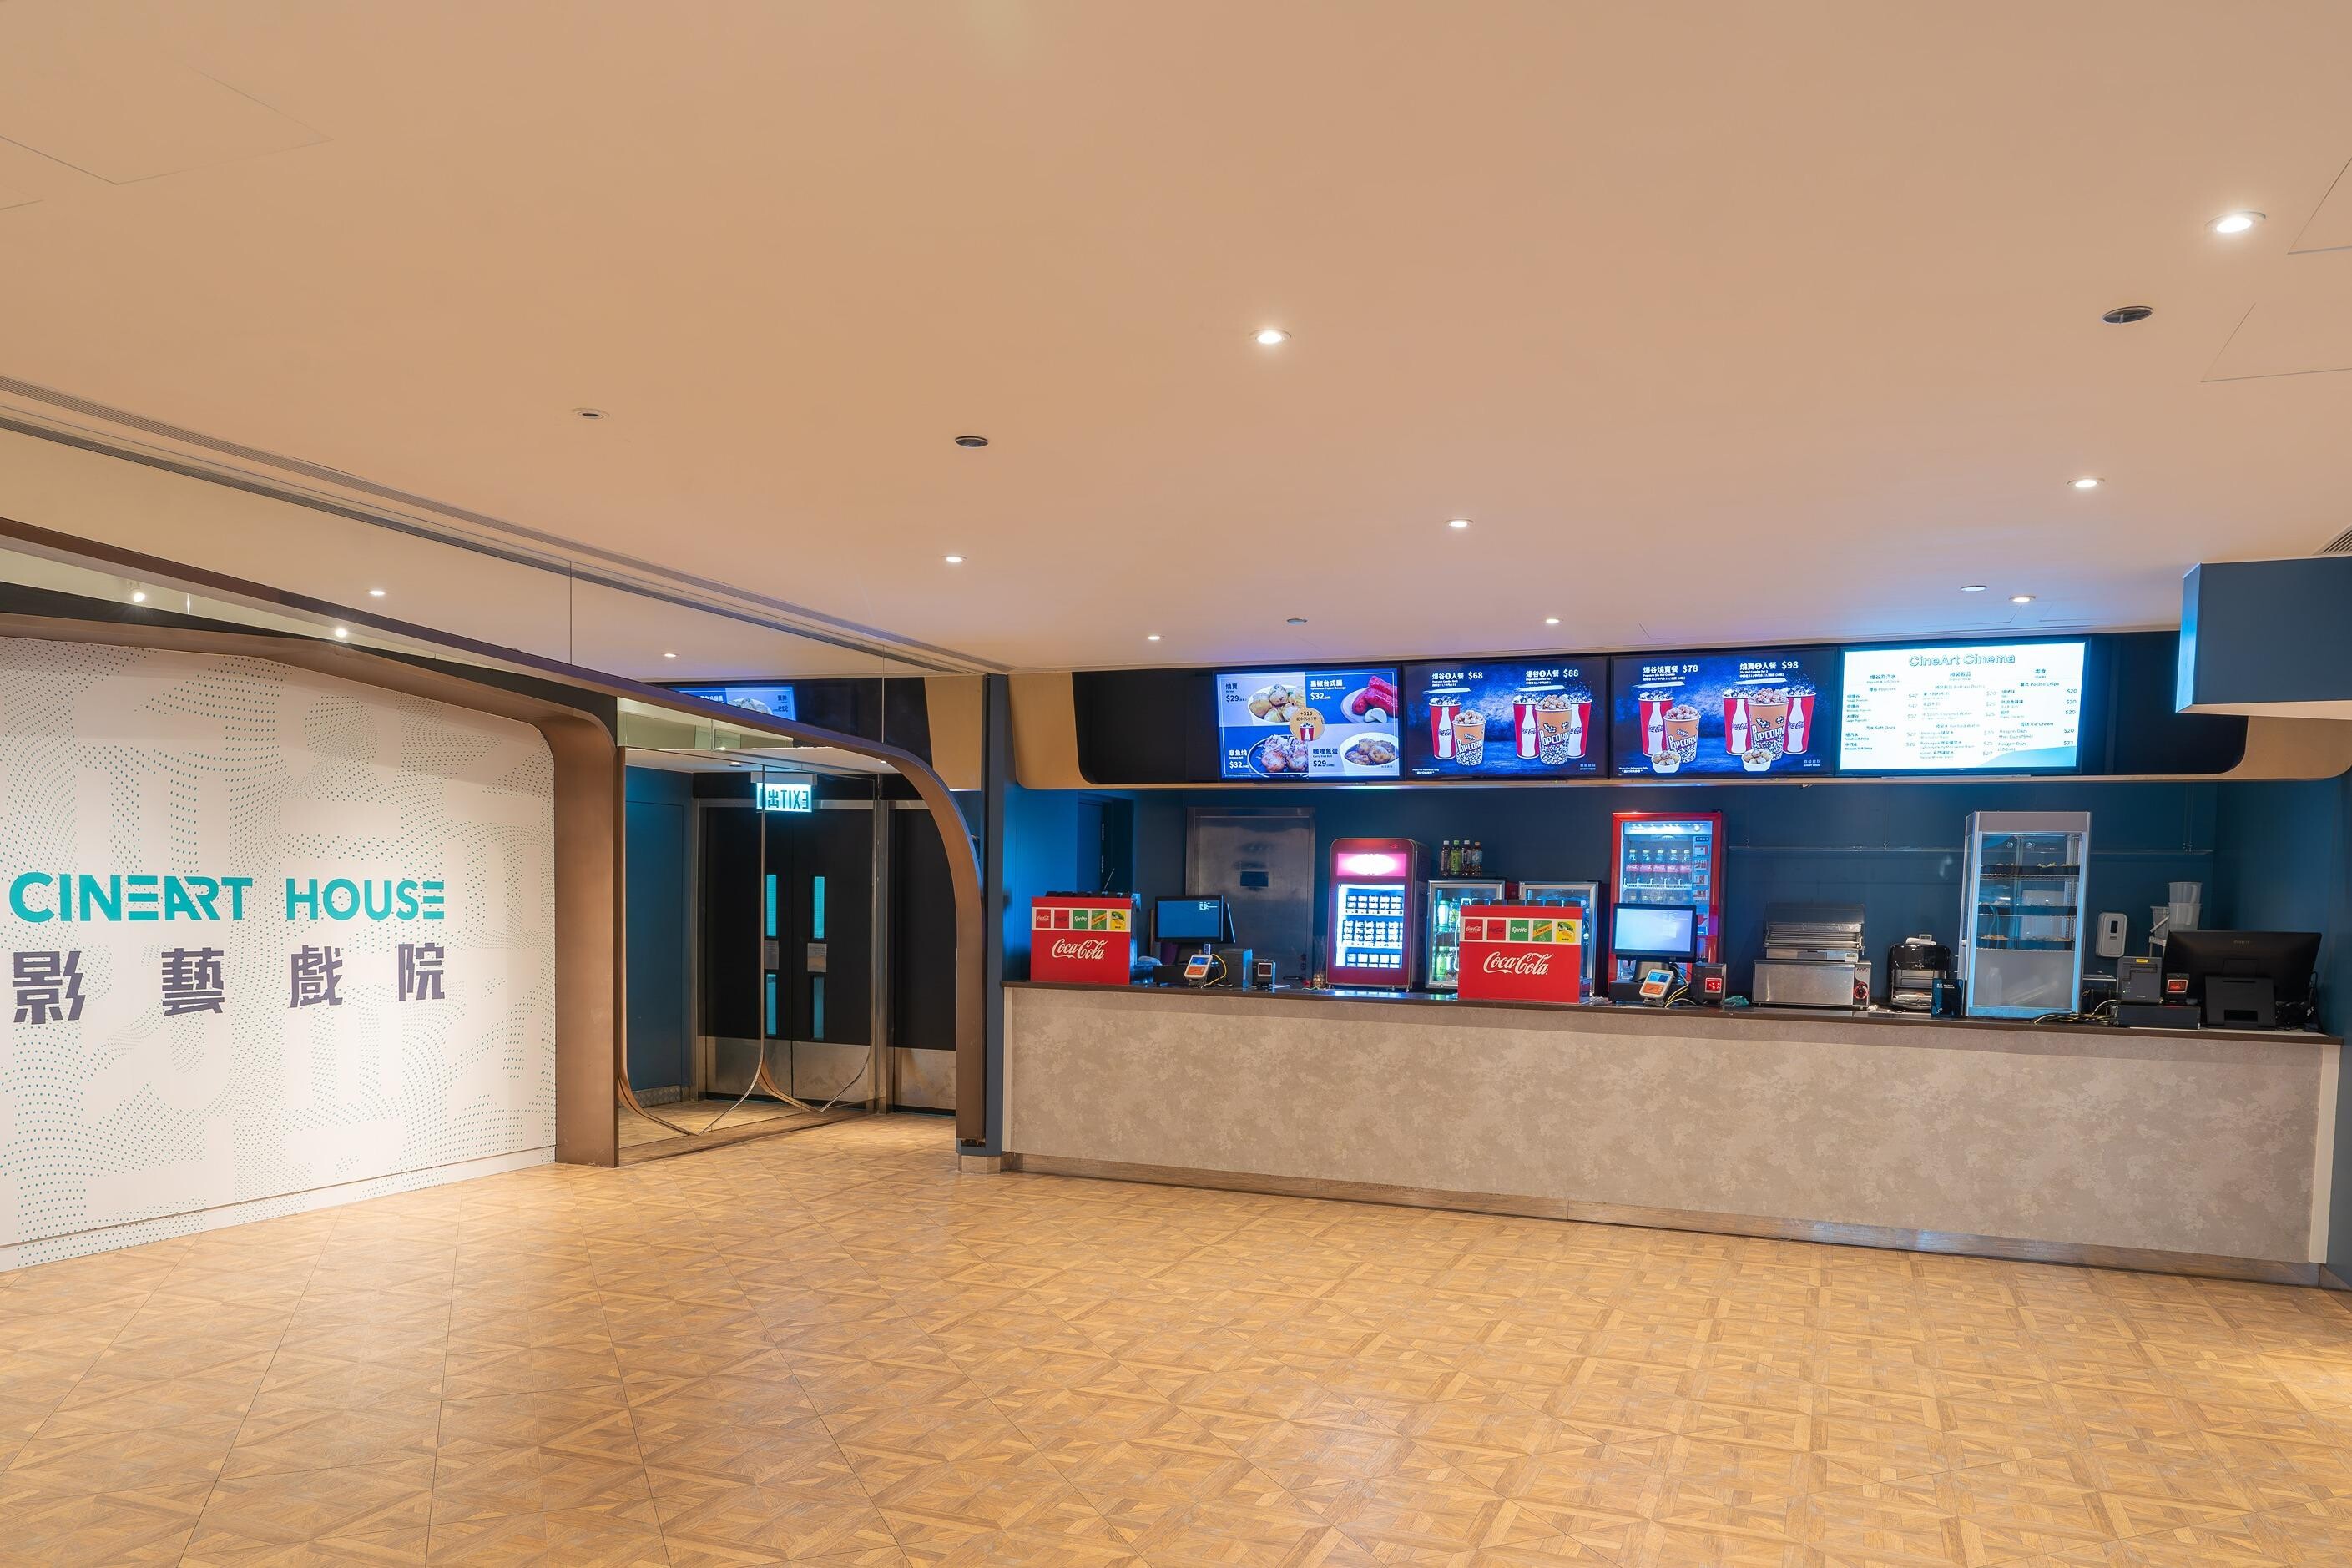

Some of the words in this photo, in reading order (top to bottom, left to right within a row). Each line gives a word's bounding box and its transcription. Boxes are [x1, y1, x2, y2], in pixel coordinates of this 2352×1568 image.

[1781, 660, 1799, 670] $98
[1909, 654, 1960, 667] CineArt
[1963, 653, 2016, 665] Cinema
[1563, 668, 1579, 678] $88
[1682, 664, 1698, 673] $78
[1468, 671, 1483, 680] $68
[1226, 694, 1239, 703] $29
[1310, 692, 1324, 701] $32
[1229, 760, 1243, 769] $32
[1313, 759, 1326, 768] $29
[9, 872, 253, 922] CINEART
[286, 878, 445, 920] HOUSE
[1052, 938, 1108, 960] Coca-Cola
[1483, 951, 1553, 976] Coca-Cola
[12, 942, 445, 1025] 影藝戲院
